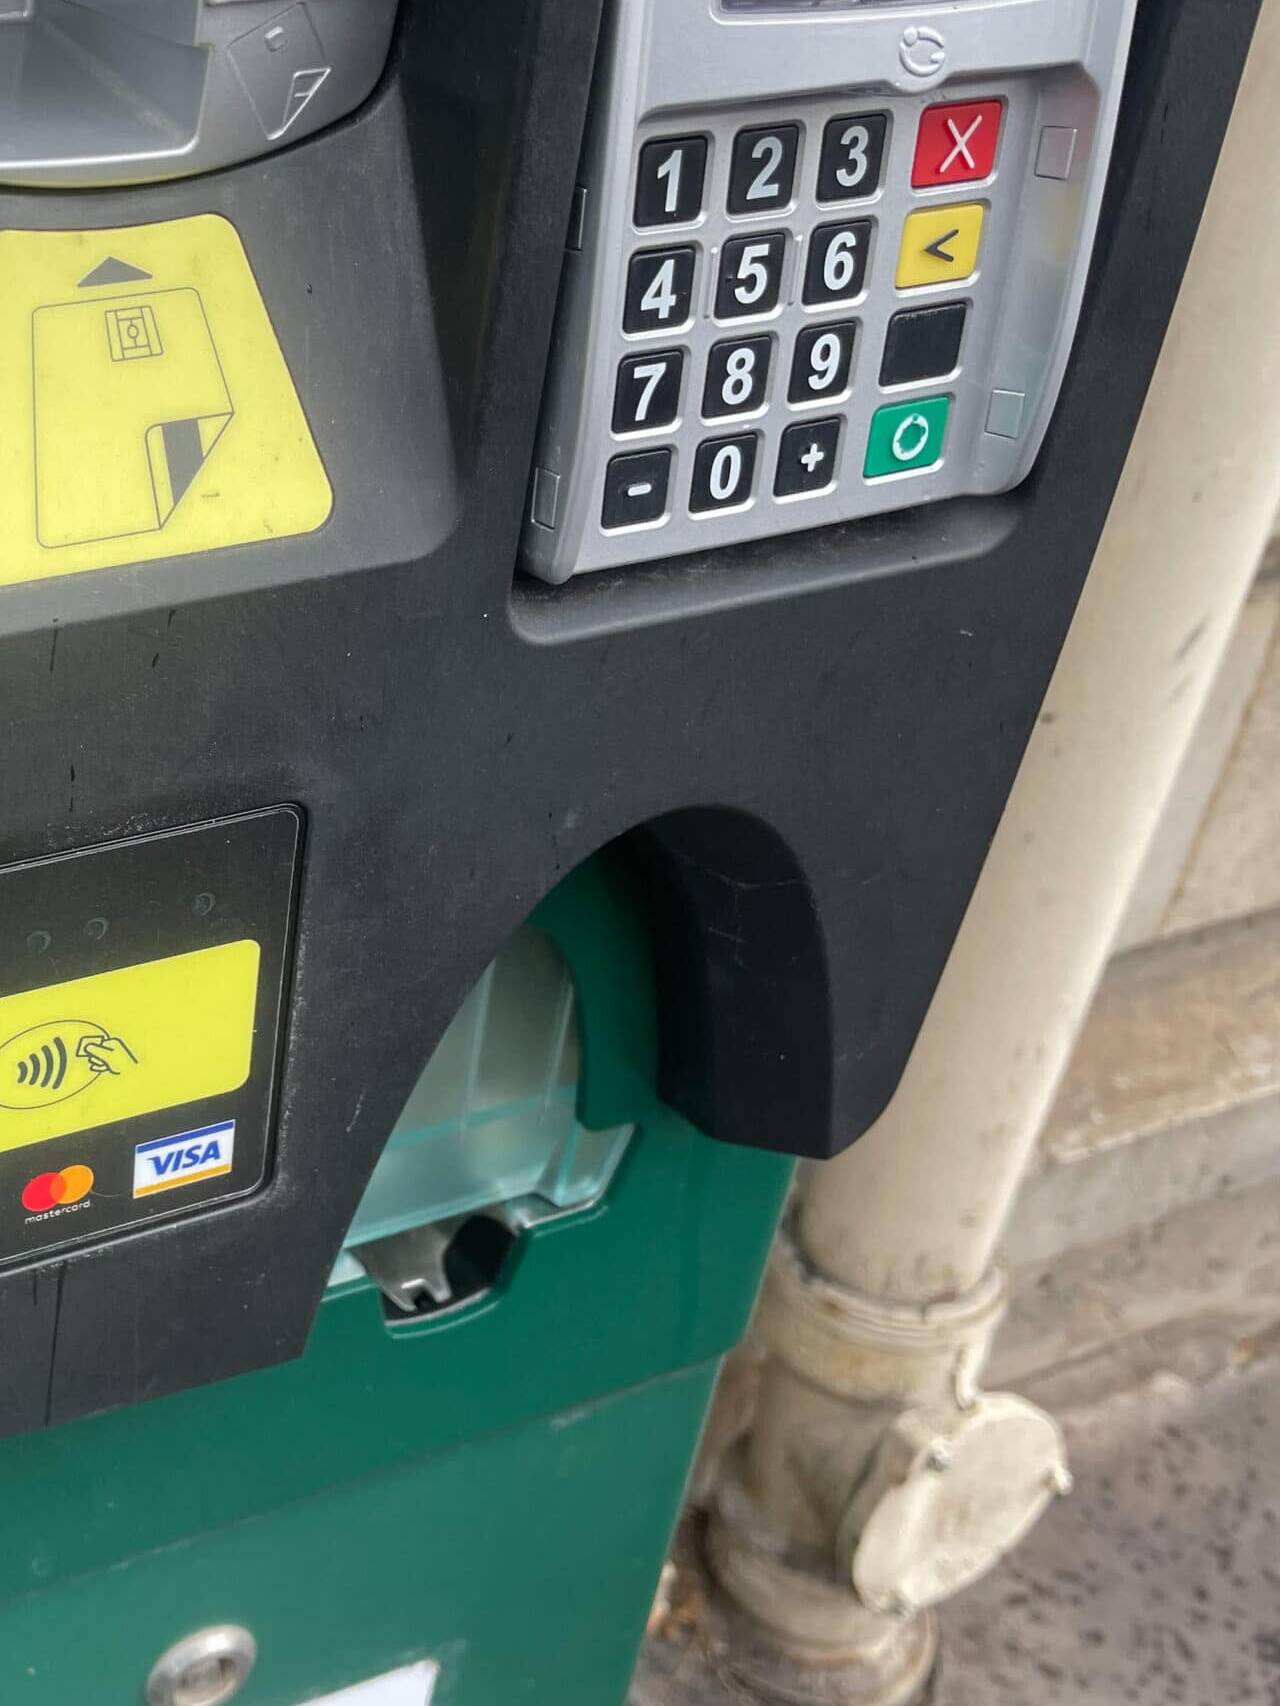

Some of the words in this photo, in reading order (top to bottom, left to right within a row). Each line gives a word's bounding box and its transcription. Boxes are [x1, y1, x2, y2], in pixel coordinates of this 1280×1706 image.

[657, 149, 683, 212] 1
[746, 137, 783, 200] 2
[836, 125, 869, 187] 3
[640, 258, 677, 319] 4
[734, 243, 770, 304] 5
[823, 231, 856, 291] 6
[633, 362, 667, 422] 7
[721, 347, 756, 405] 8
[808, 333, 841, 391] 9
[709, 445, 742, 500] 0
[147, 1139, 222, 1176] VISA
[24, 1199, 92, 1225] mastercard
